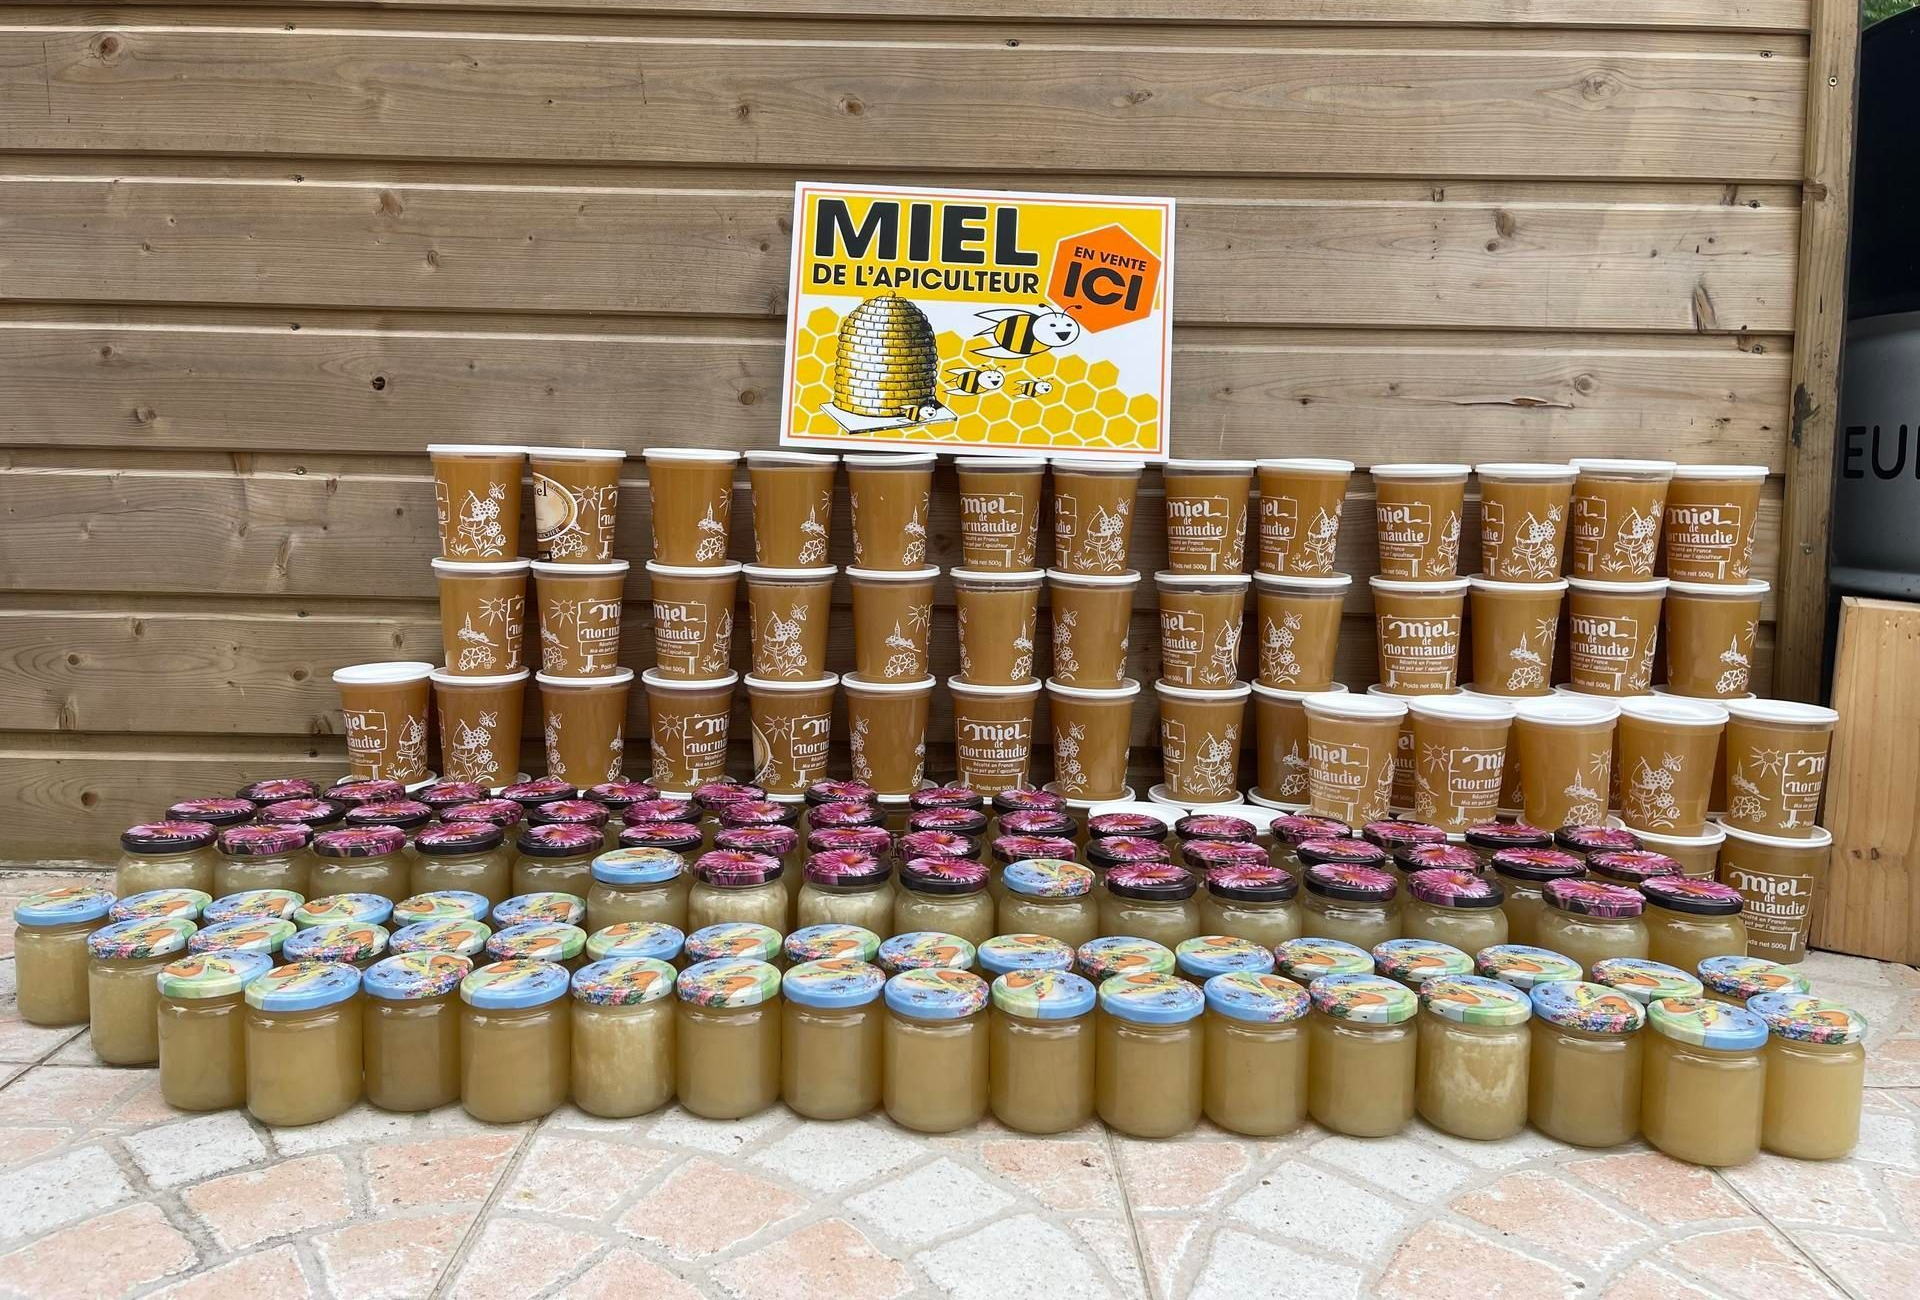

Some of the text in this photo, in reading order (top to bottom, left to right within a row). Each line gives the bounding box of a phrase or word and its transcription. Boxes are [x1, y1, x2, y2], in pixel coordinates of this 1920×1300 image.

[815, 199, 1038, 266] MIEL
[1074, 246, 1147, 272] EN VENTE
[812, 265, 1039, 294] DE L'APICULTEUR
[1063, 261, 1142, 311] ICI
[979, 512, 987, 522] de
[1184, 516, 1192, 524] de
[1689, 522, 1698, 532] de
[1422, 636, 1432, 646] de
[1588, 634, 1596, 643] de
[994, 738, 1003, 748] de
[1320, 760, 1328, 770] de
[1764, 892, 1776, 902] de
